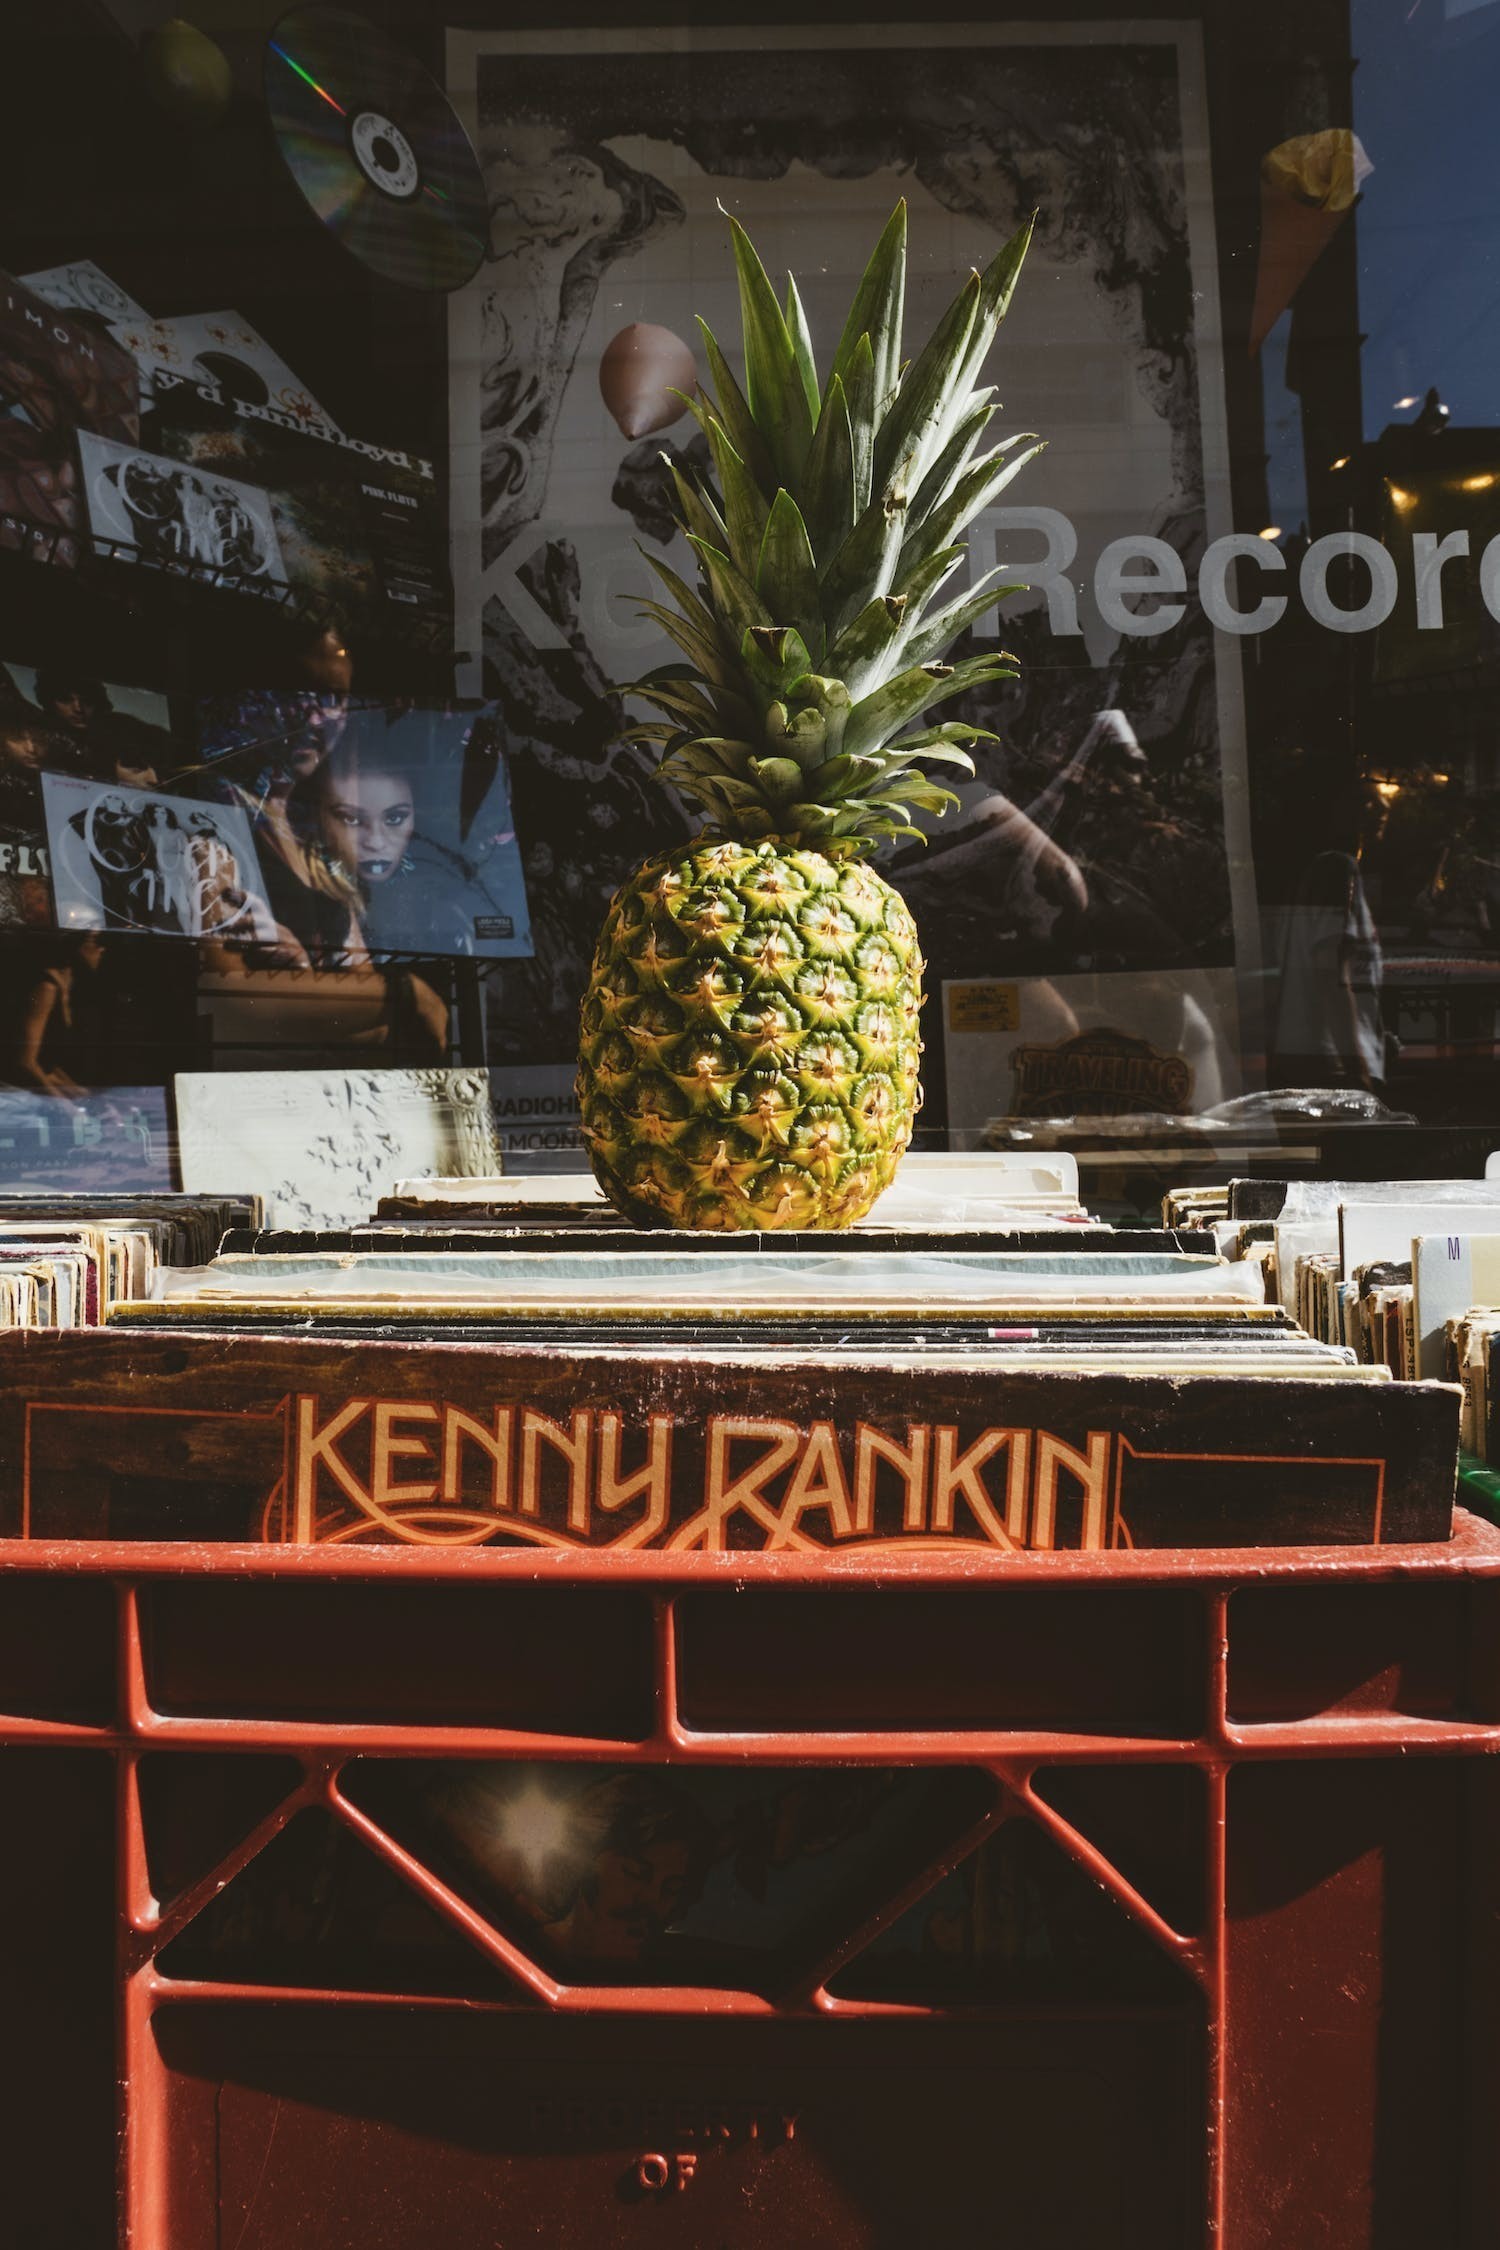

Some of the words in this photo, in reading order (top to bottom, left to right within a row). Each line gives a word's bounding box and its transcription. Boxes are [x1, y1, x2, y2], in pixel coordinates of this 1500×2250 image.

[968, 506, 1500, 640] Recor
[1447, 1236, 1460, 1261] M
[297, 1394, 674, 1550] KENNY
[680, 1415, 1113, 1552] RANKIN
[639, 2152, 698, 2192] OF
